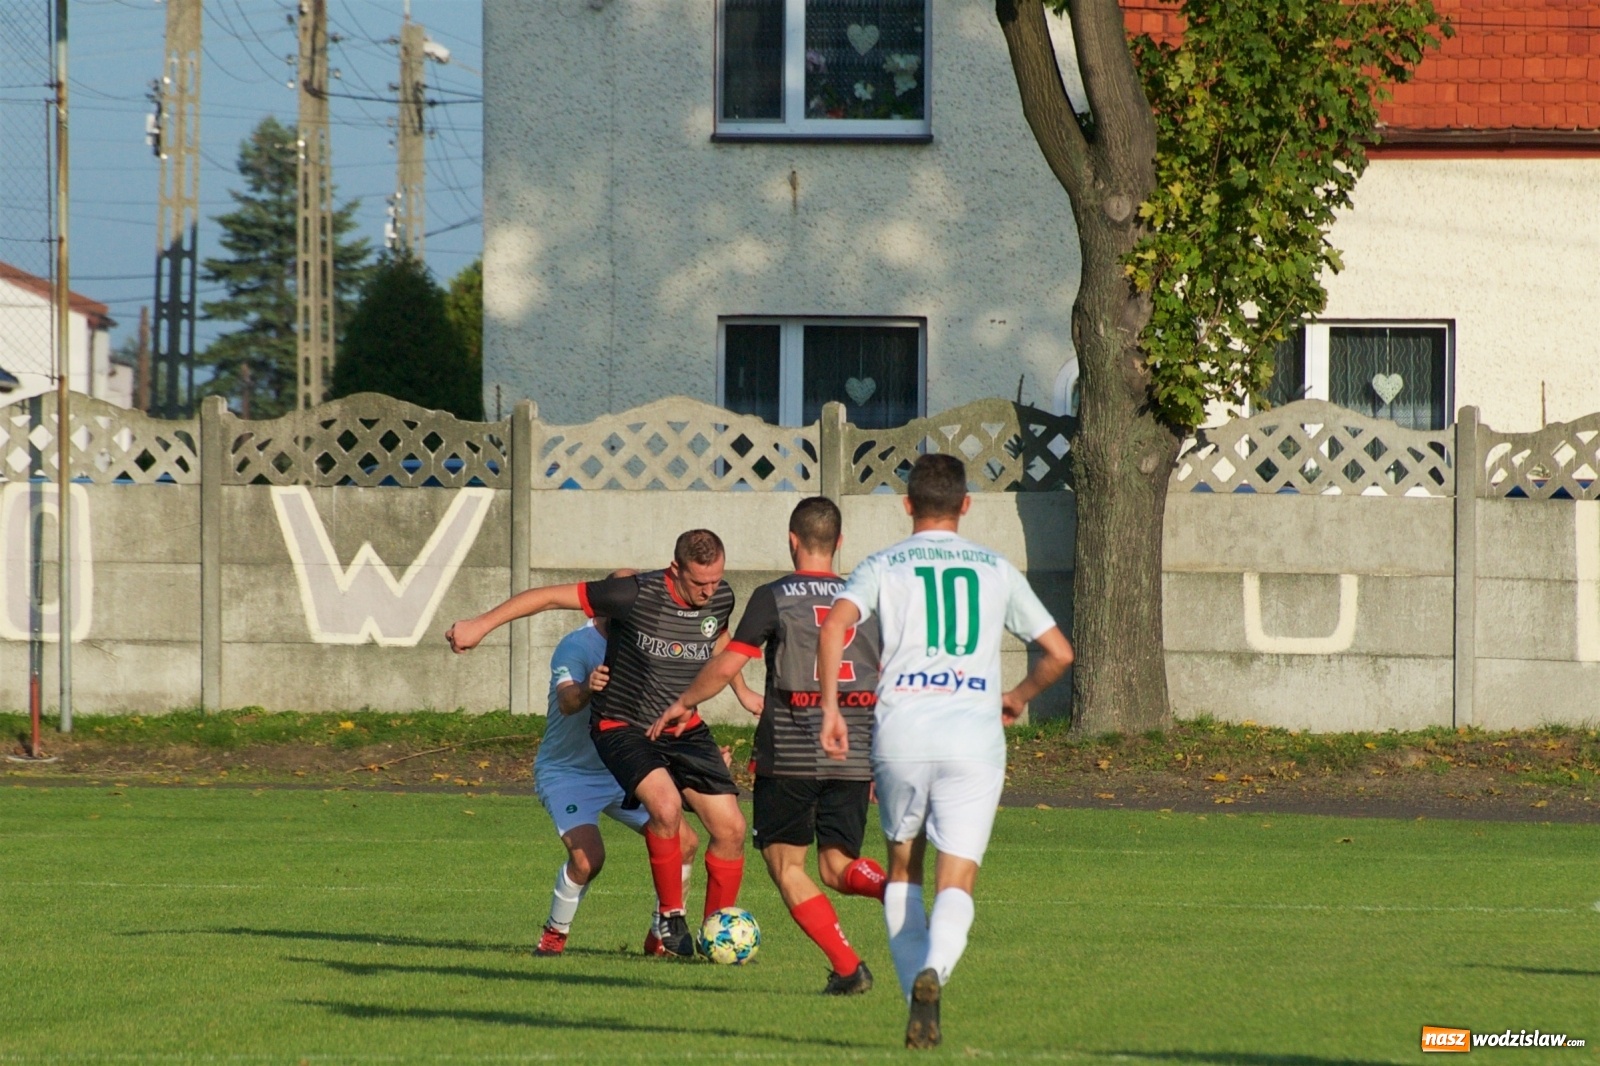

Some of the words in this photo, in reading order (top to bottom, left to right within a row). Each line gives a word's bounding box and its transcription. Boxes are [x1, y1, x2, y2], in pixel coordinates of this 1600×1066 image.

[782, 582, 807, 597] LKS
[914, 566, 980, 657] 10
[636, 631, 717, 661] PROSA
